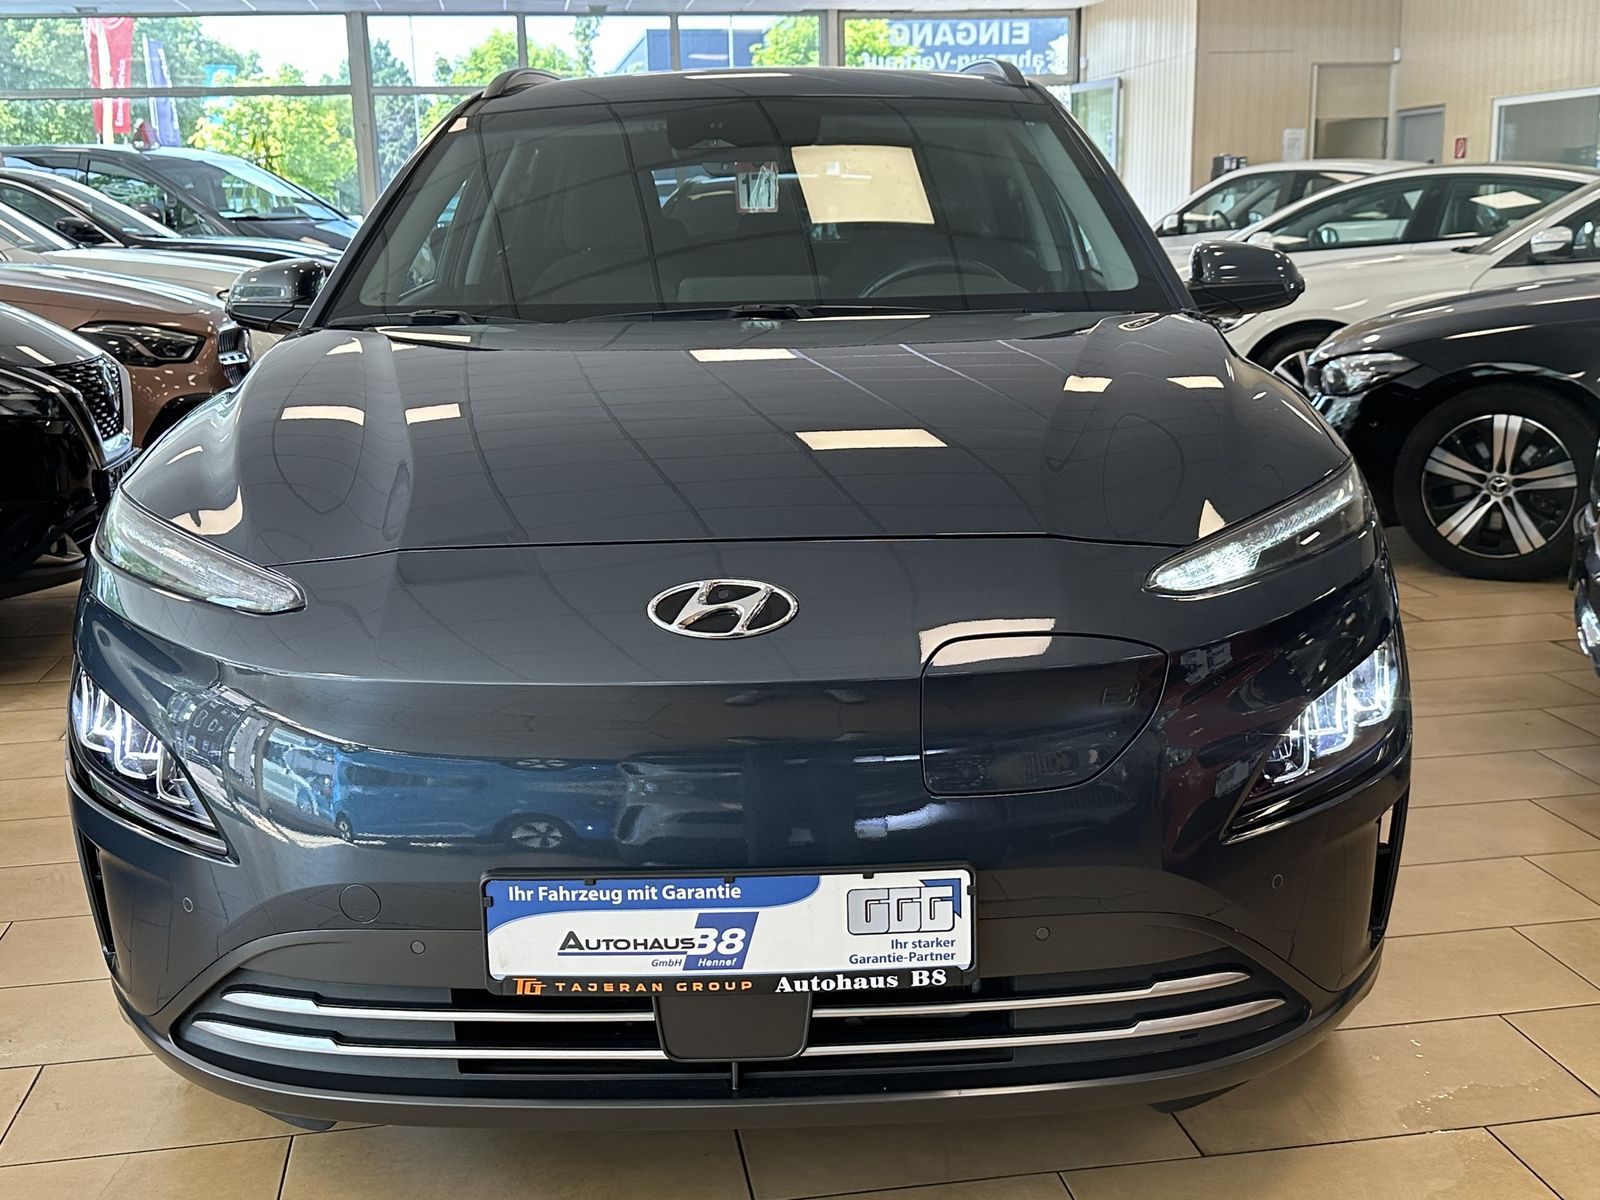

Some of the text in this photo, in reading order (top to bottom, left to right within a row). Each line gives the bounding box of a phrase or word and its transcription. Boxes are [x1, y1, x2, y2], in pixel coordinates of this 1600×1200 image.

[508, 883, 741, 905] Ihr Fahrzeug mit Garantie
[890, 937, 956, 950] Ihr starker
[651, 957, 737, 968] GmbH Hennef
[849, 952, 956, 965] Garantie-Partner
[555, 982, 663, 992] TAJERAN
[675, 981, 753, 992] GROUP
[774, 969, 947, 993] Autohaus B8
